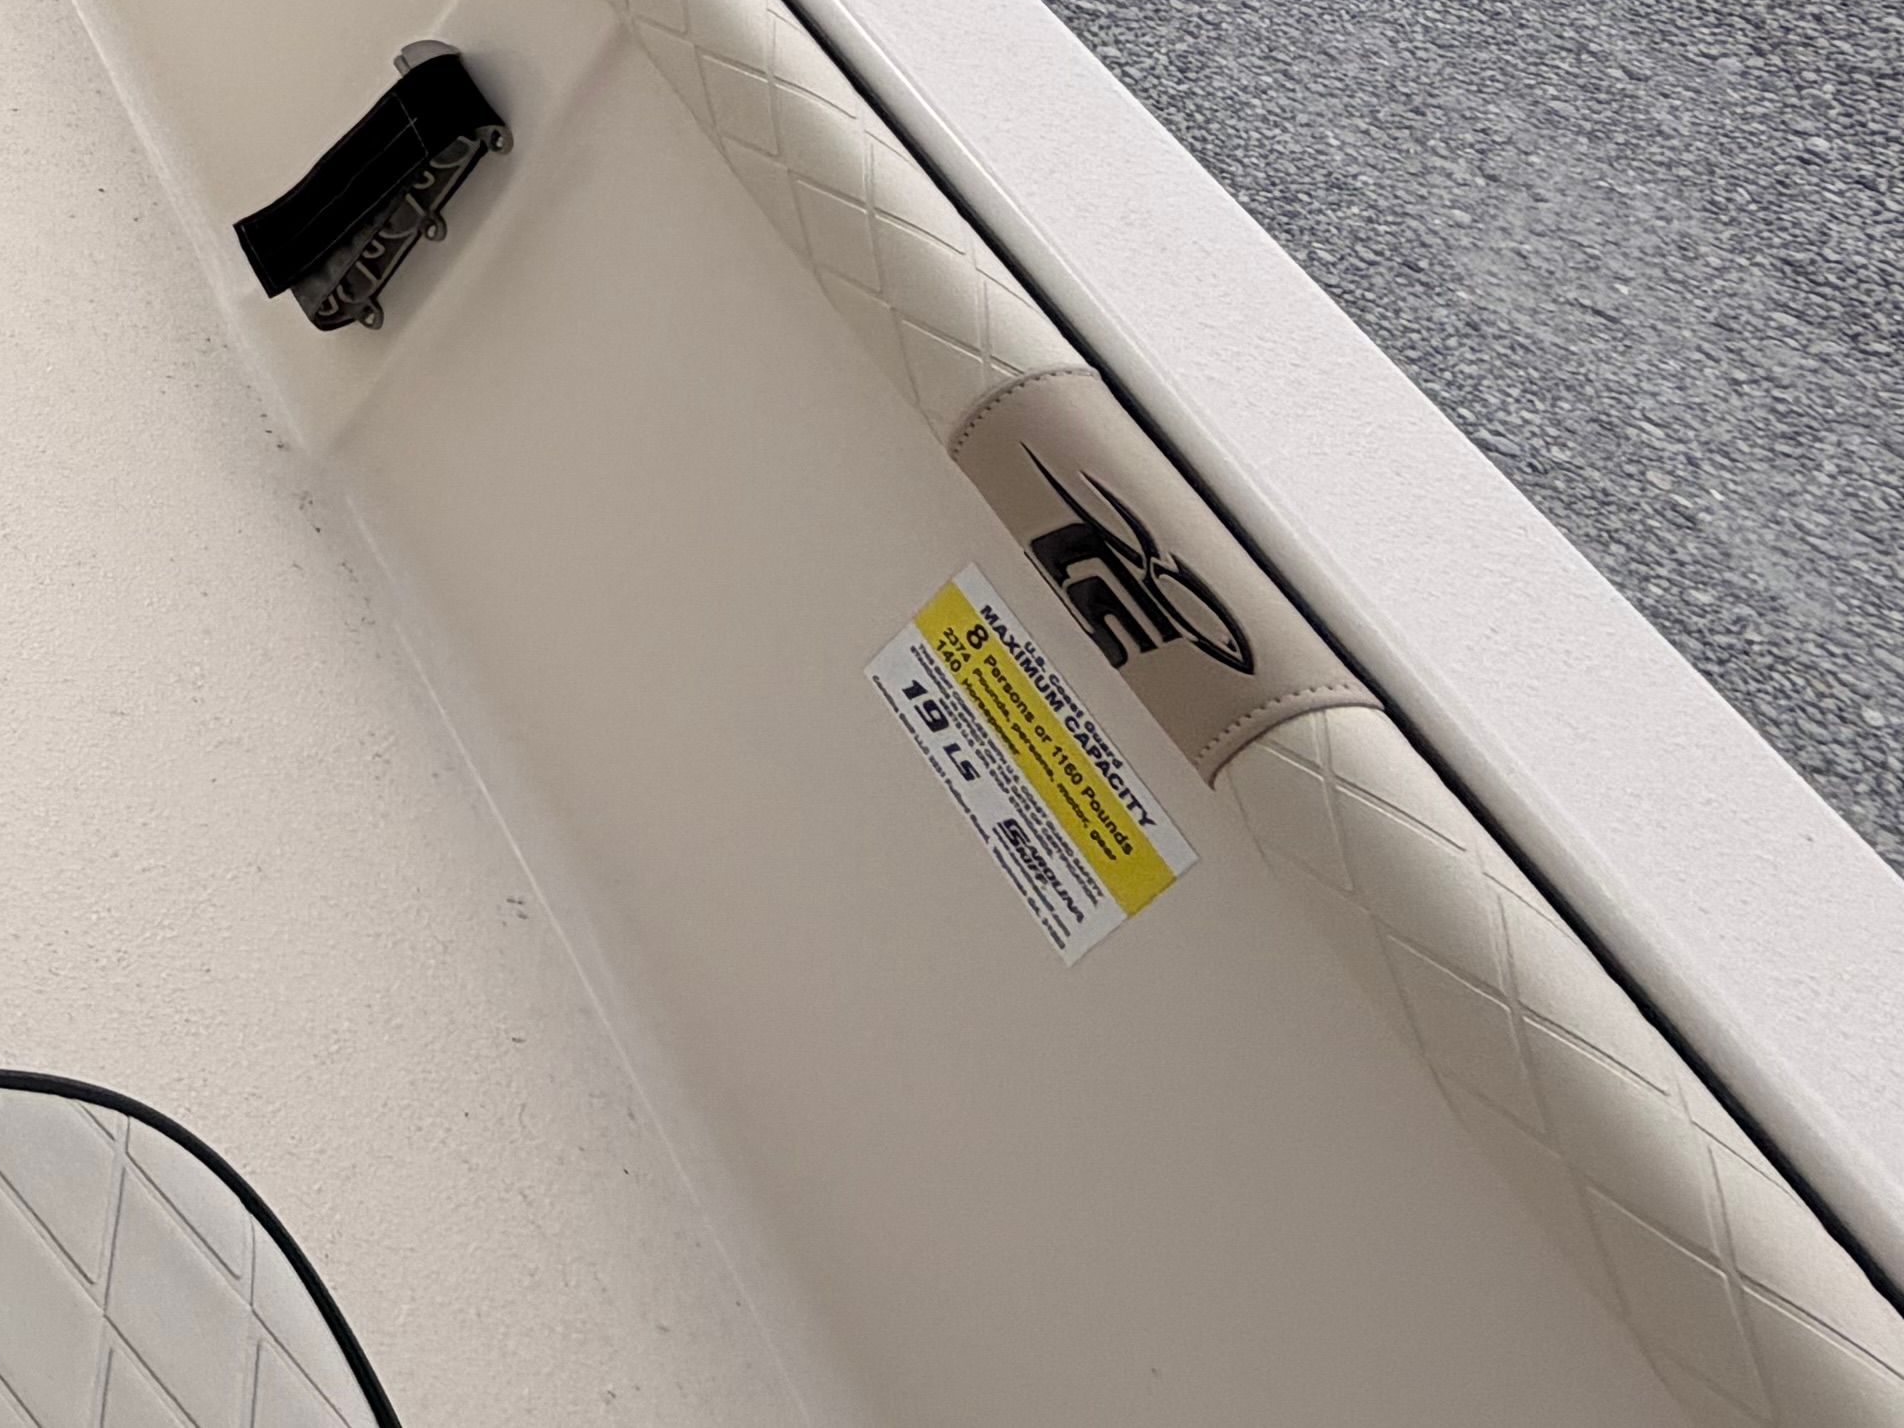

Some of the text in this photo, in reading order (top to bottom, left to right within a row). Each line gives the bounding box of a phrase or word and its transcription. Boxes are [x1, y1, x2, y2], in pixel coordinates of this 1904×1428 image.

[934, 637, 963, 674] 140
[901, 674, 981, 787] 19 LS
[963, 621, 991, 652] 8
[982, 653, 1037, 724] Persons
[1032, 722, 1053, 746] or
[1079, 784, 1136, 856] Pounds
[979, 603, 1157, 833] MAXIMUM CAPACITY
[1082, 719, 1124, 770] Guard
[1003, 813, 1086, 925] CAROLINA
